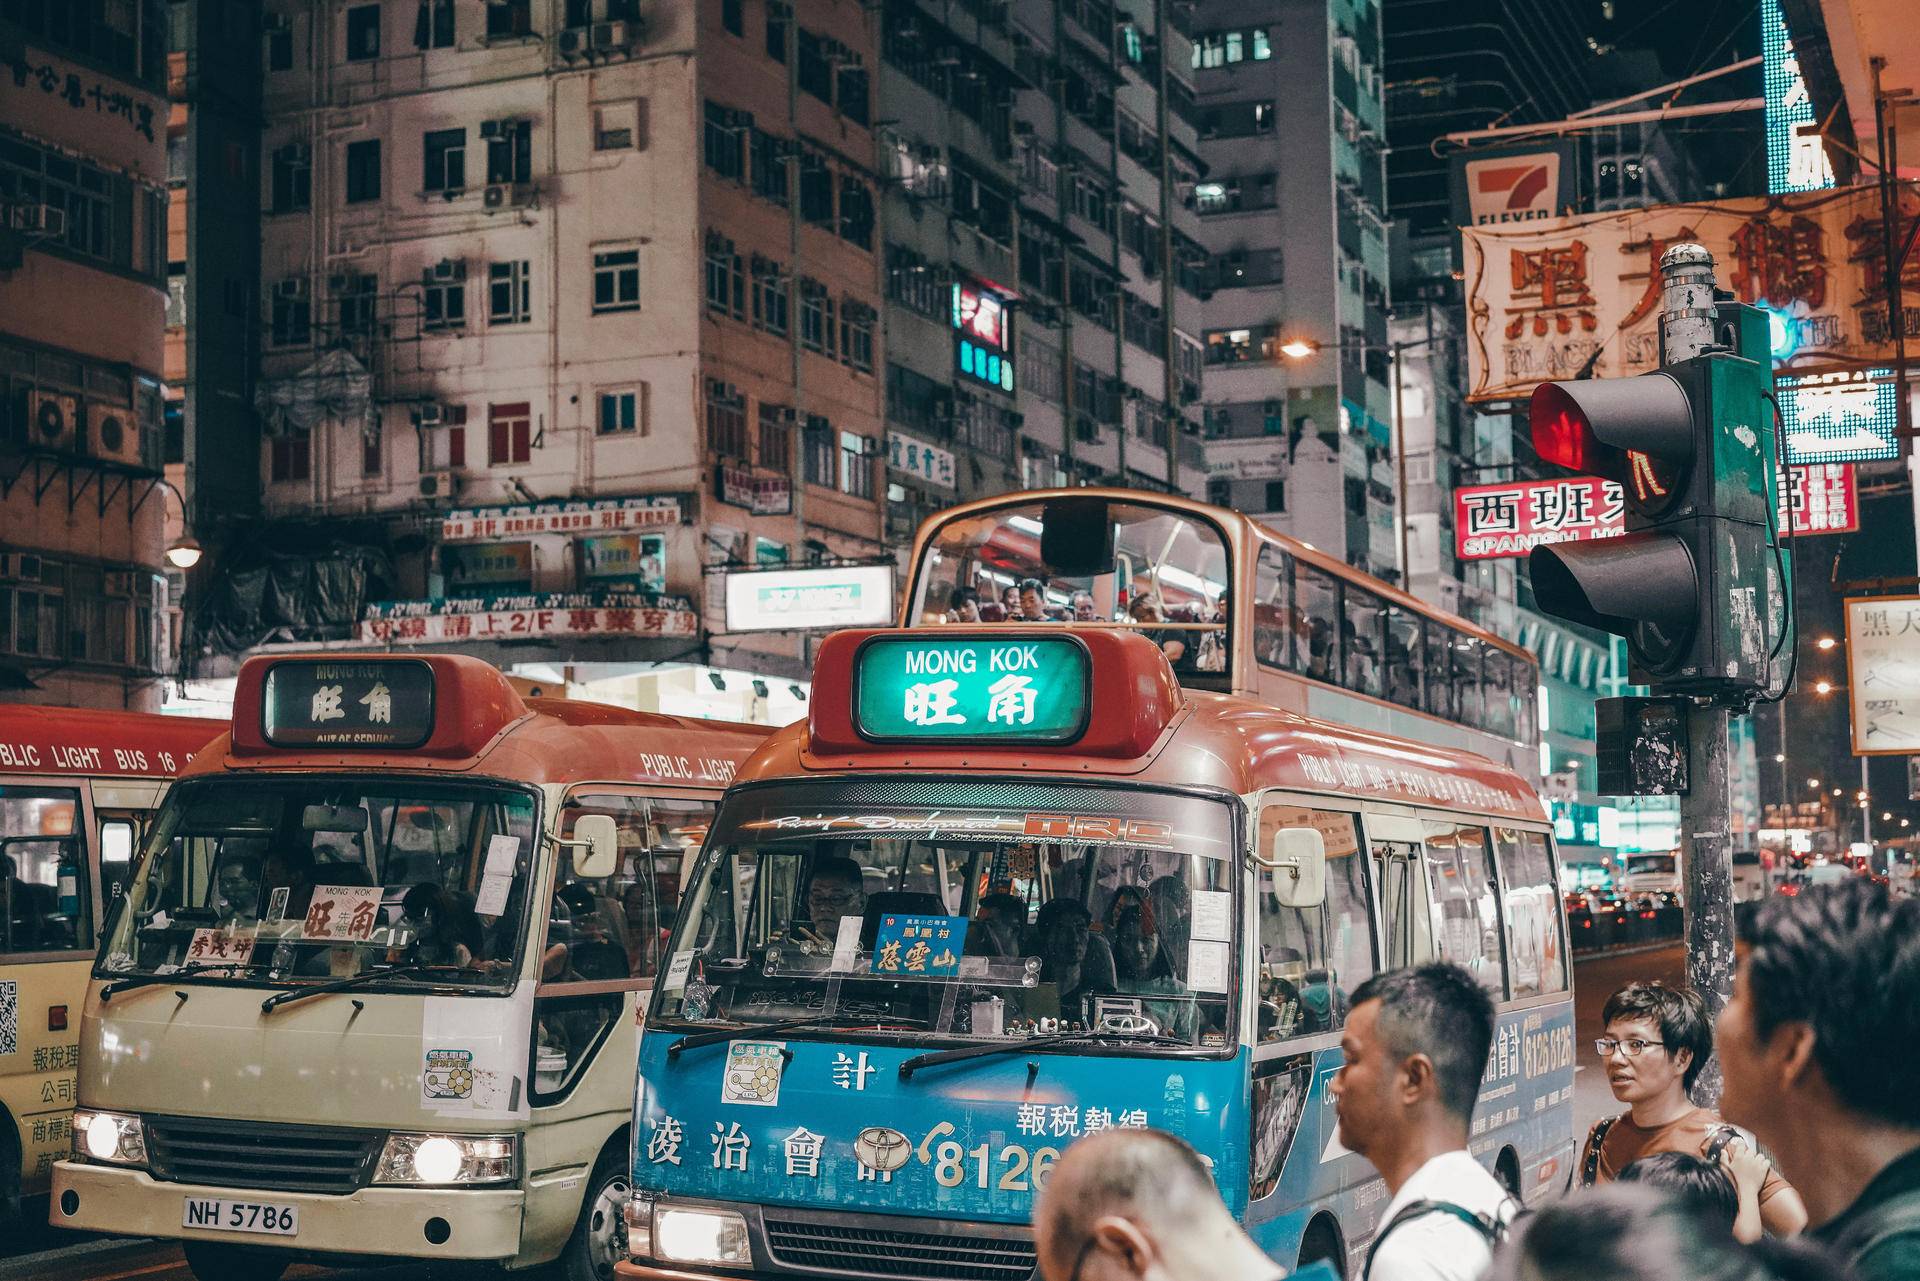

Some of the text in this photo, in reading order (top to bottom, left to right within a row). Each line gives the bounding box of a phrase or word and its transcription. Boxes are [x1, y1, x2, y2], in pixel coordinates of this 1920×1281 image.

[1478, 165, 1548, 210] 7
[906, 645, 1039, 674] MONG KOK
[311, 681, 392, 724] 旺角
[904, 674, 1038, 725] 旺角
[51, 745, 102, 769] LIGHT
[114, 749, 149, 771] BUS
[157, 751, 176, 773] 16
[640, 753, 737, 782] PUBLIC LIGHT
[1297, 752, 1337, 784] PUBLIC
[1337, 760, 1366, 789] LIGHT
[1366, 764, 1387, 790] BUS
[1025, 814, 1173, 842] TRD
[325, 887, 371, 896] MONG KOK
[303, 900, 375, 940] 旺角
[877, 939, 957, 972] 慈雲山
[832, 1051, 876, 1091] 計
[1525, 1024, 1572, 1080] 8126 8126
[934, 1140, 1063, 1192] 8126
[188, 1200, 294, 1231] NH 5786
